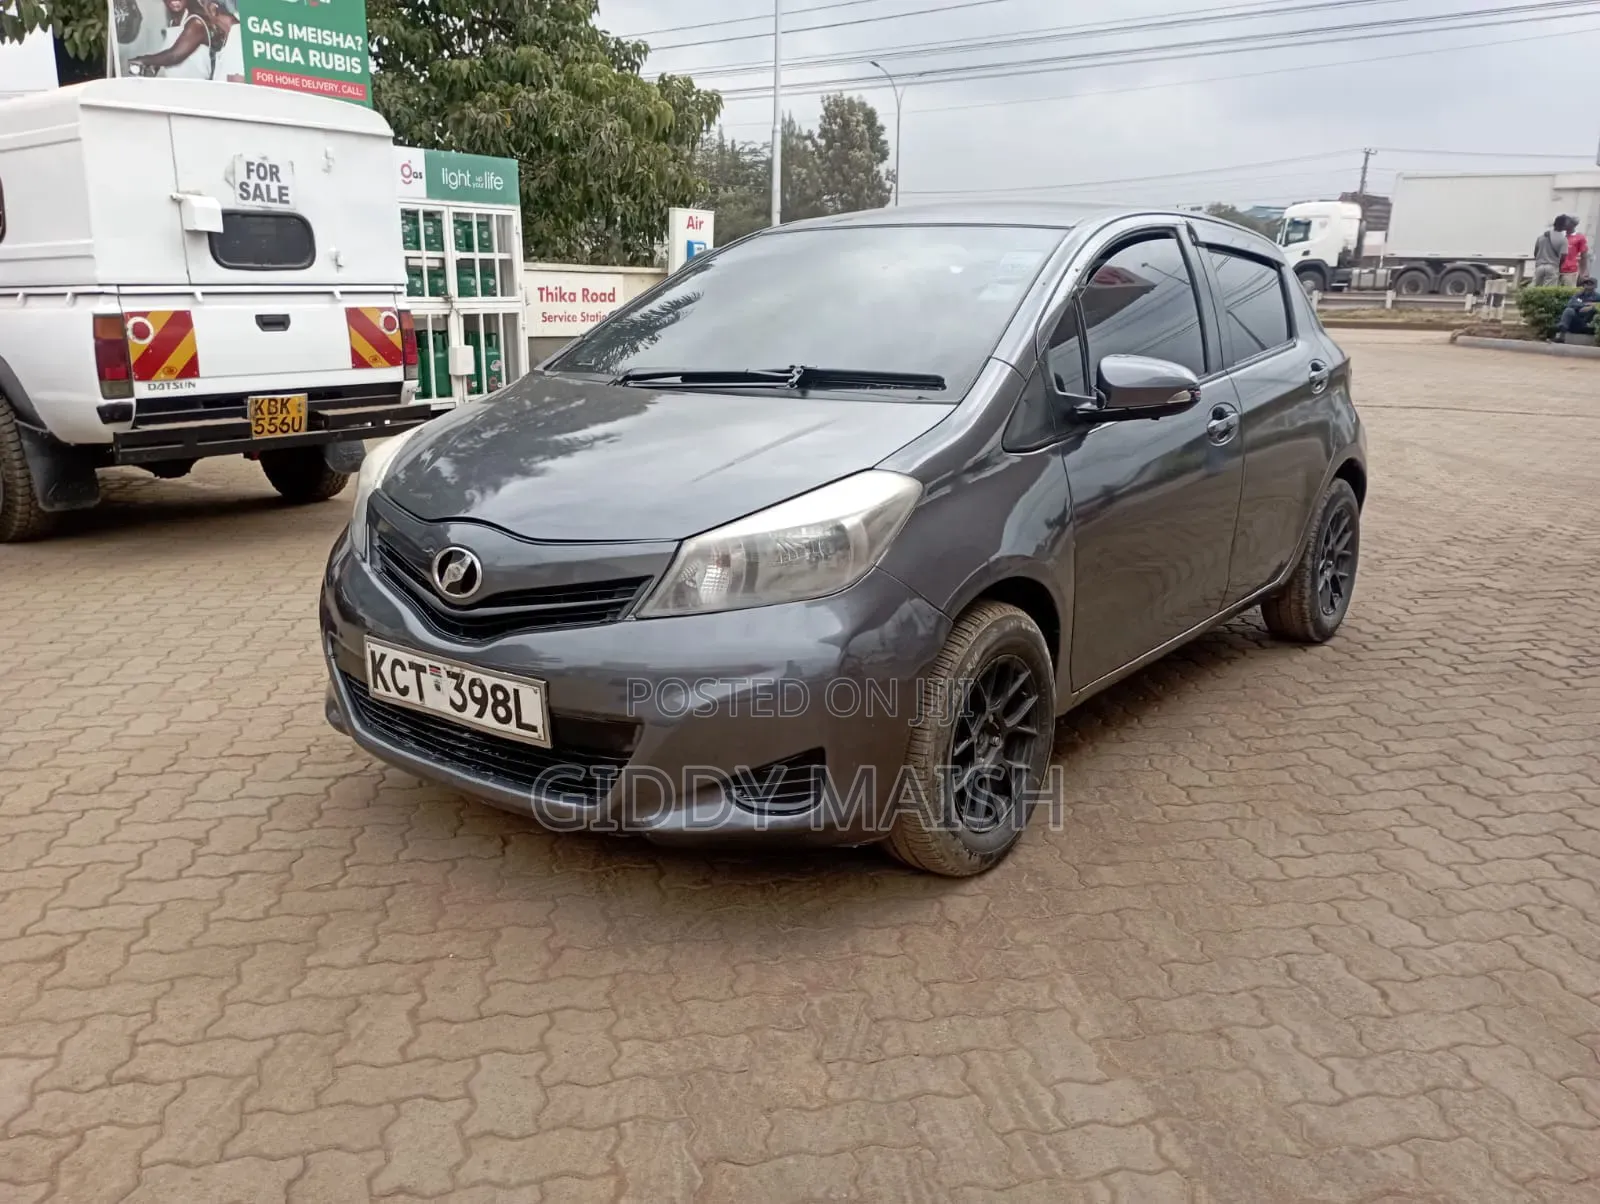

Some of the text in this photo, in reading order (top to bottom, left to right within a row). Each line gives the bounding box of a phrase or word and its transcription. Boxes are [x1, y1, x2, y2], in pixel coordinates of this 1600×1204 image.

[247, 16, 363, 52] GAS IMEISHA?
[252, 40, 362, 74] PIGIA RUBIS
[256, 71, 274, 82] FOR
[275, 75, 301, 87] HOME
[341, 84, 363, 96] CALL:
[246, 161, 281, 183] FOR
[441, 167, 471, 190] light
[484, 171, 504, 191] life
[239, 181, 290, 204] SALE
[686, 215, 705, 231] Air
[537, 286, 616, 304] Thika Road
[541, 311, 609, 324] Service Statio
[147, 381, 197, 391] DATSUN
[254, 398, 291, 415] KBK
[254, 416, 303, 434] 556U
[370, 650, 538, 733] KCT 398L
